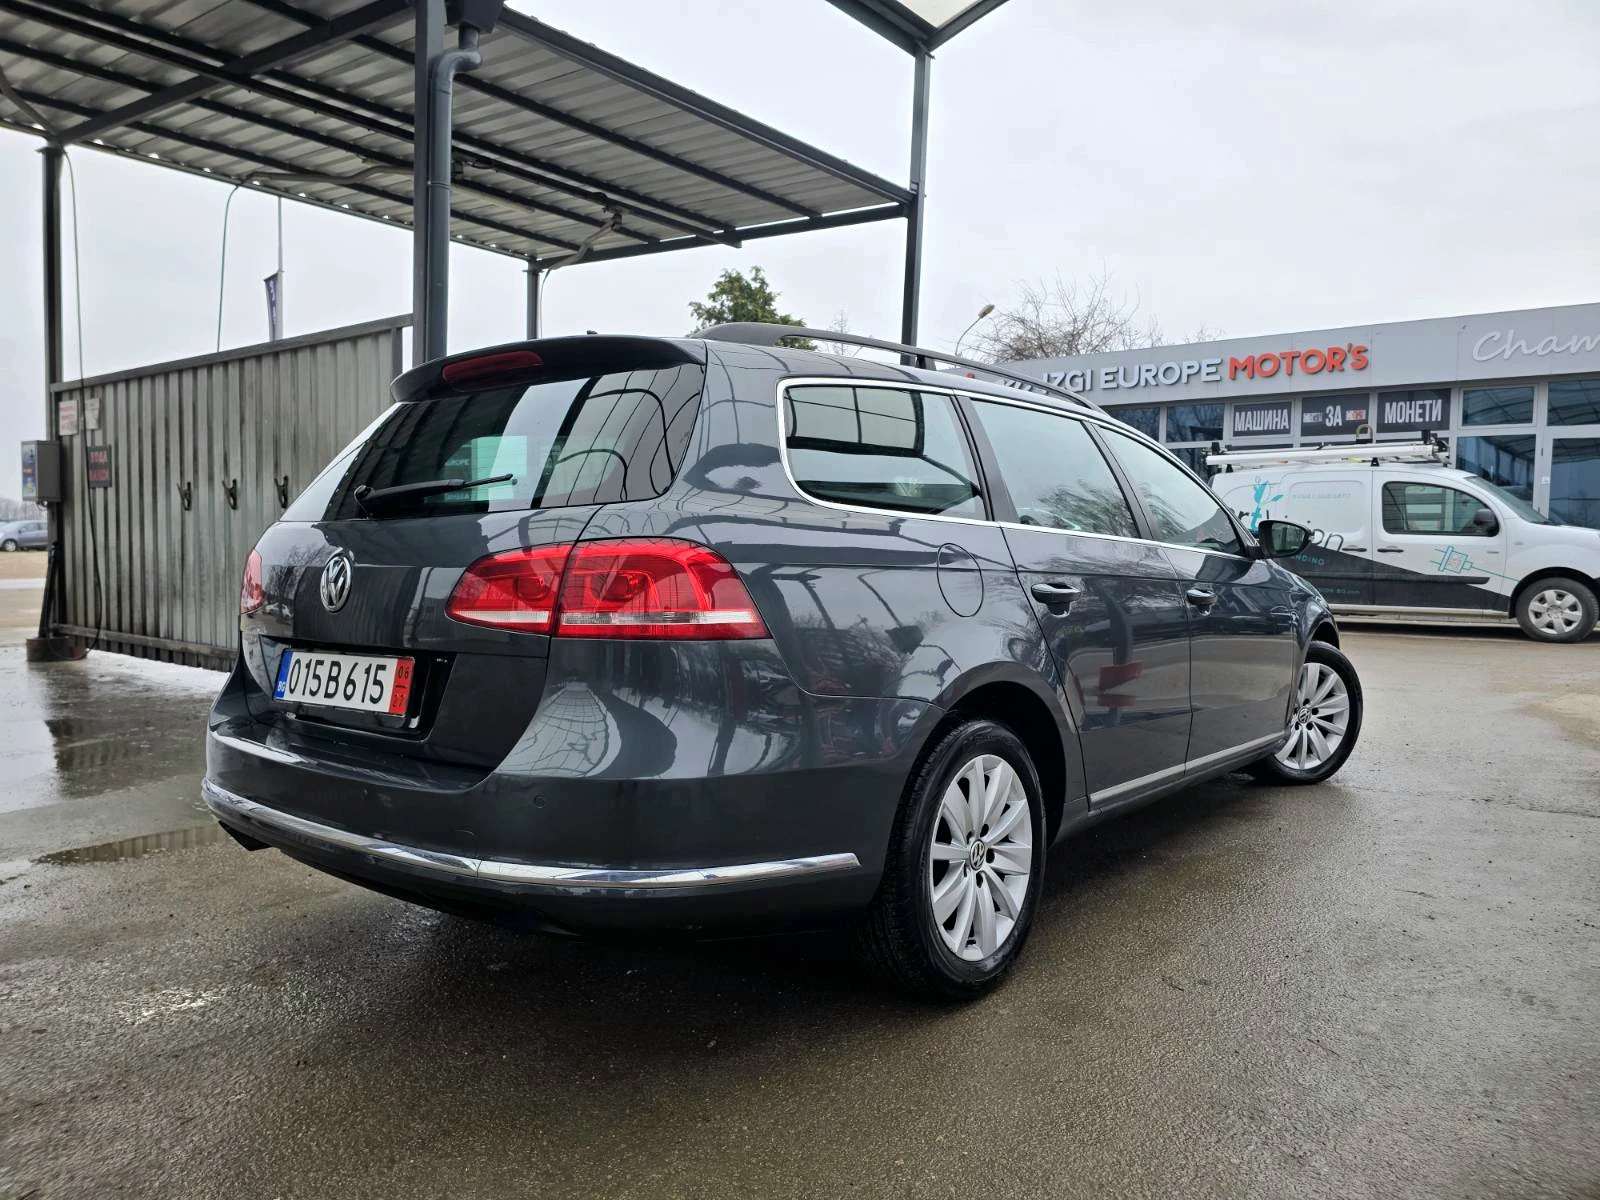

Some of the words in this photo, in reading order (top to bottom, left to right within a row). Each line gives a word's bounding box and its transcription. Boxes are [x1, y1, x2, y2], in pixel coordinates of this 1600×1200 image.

[1100, 358, 1224, 390] EUROPE
[1229, 343, 1369, 380] MOTOR'S
[1234, 408, 1290, 432] МАШИНА
[1325, 404, 1343, 427] ЗА
[1384, 399, 1442, 424] МОНЕТИ
[277, 681, 286, 692] BG
[288, 658, 388, 705] 015B615
